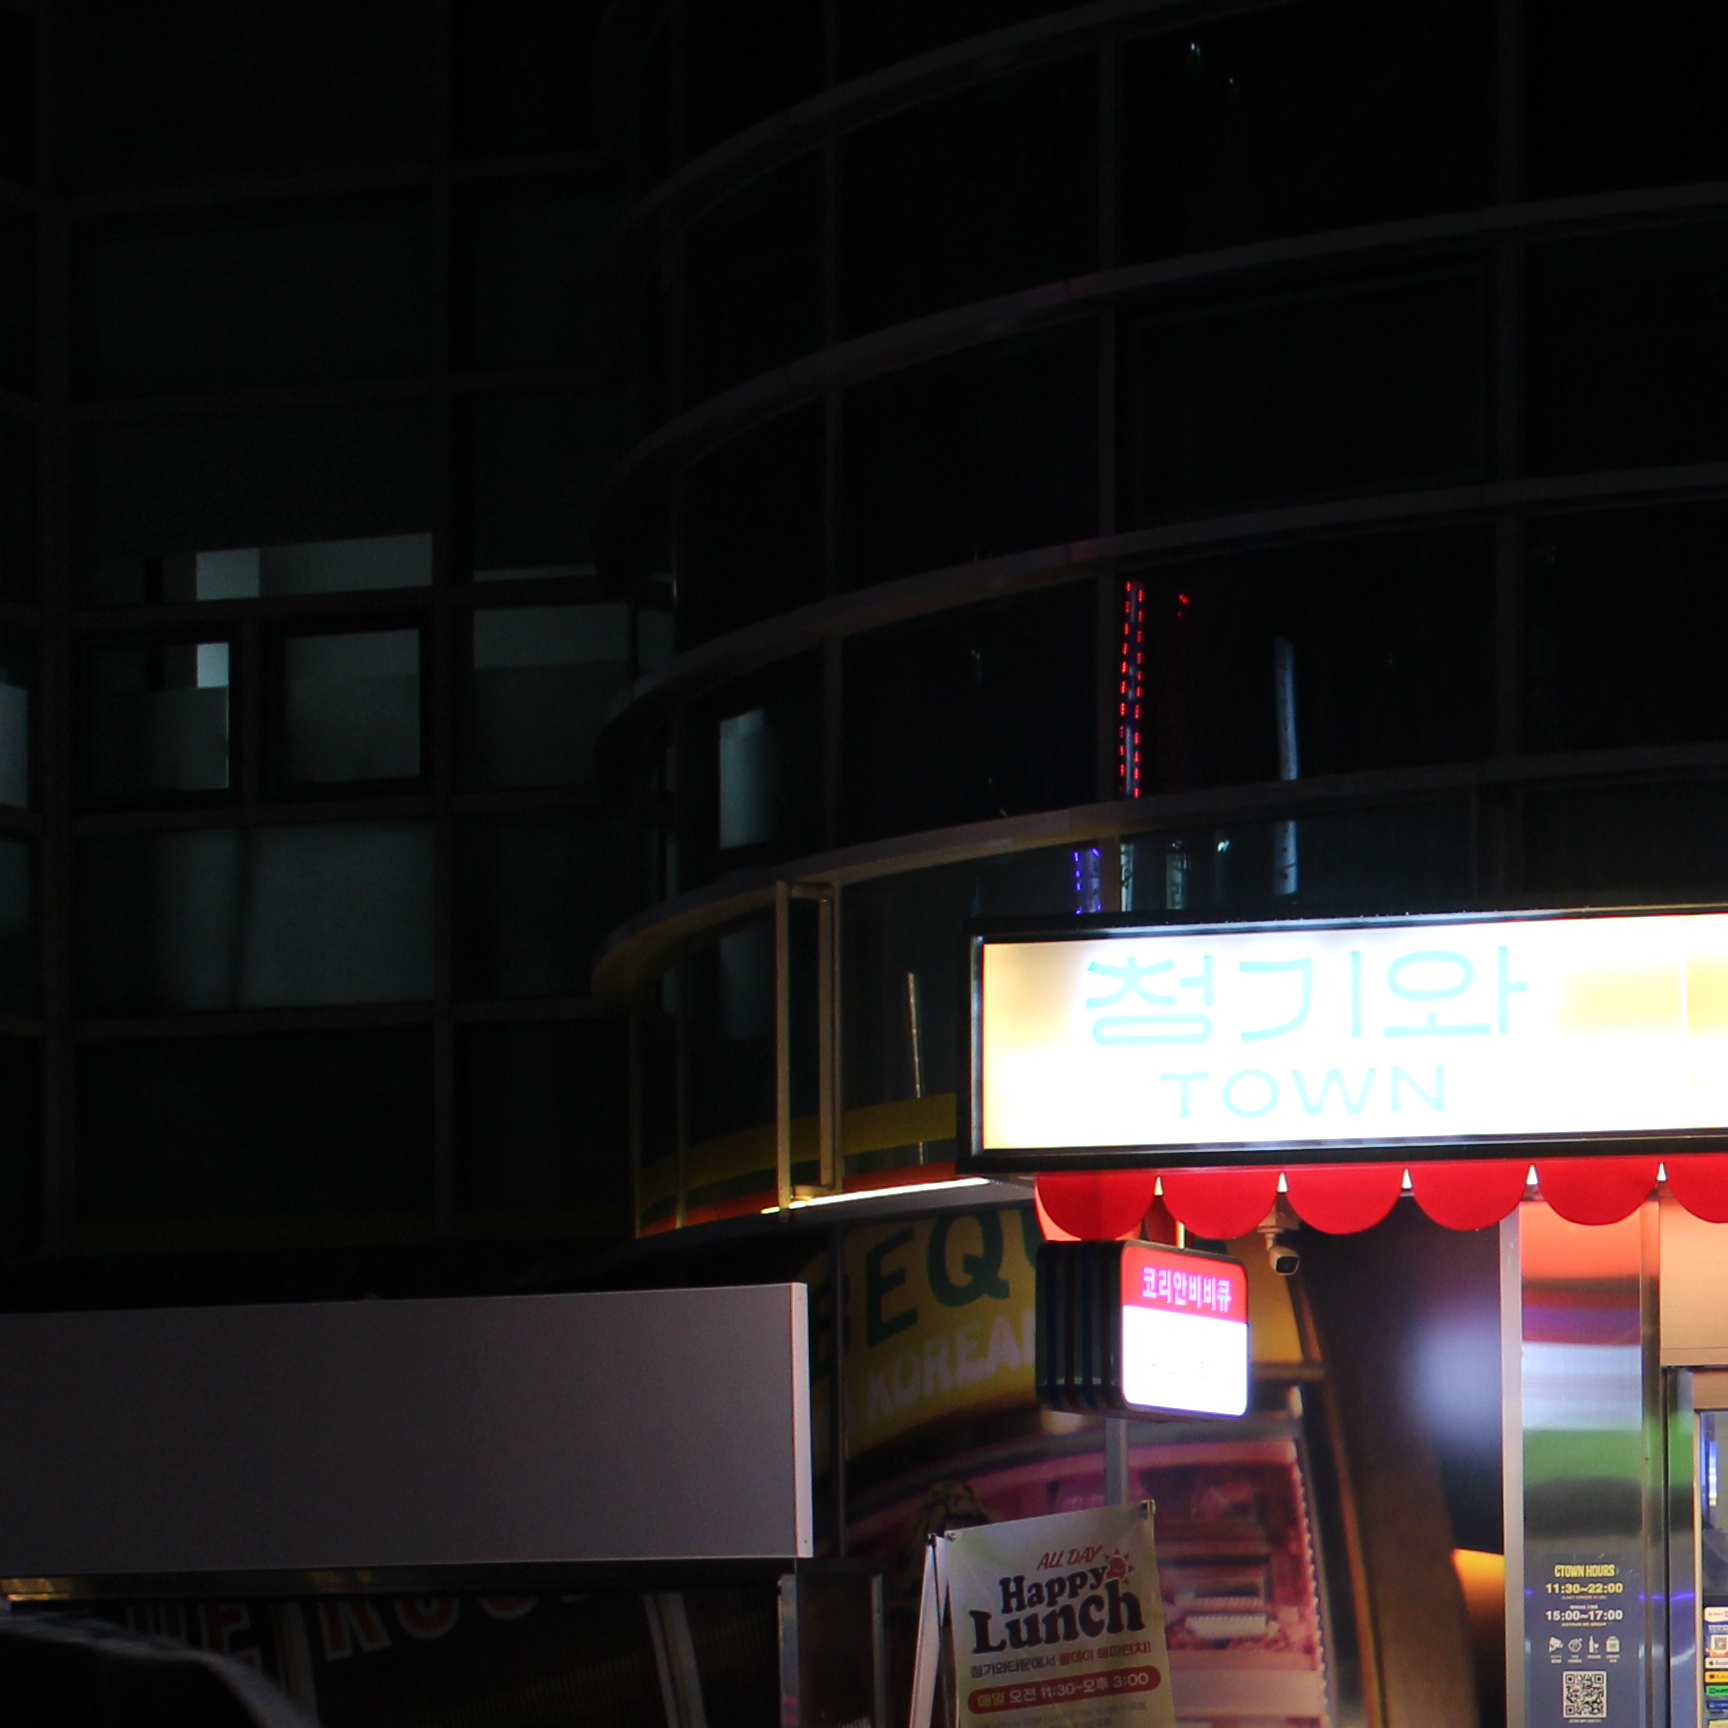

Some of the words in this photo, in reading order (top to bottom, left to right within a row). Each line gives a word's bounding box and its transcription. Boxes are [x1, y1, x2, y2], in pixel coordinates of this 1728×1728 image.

[1085, 945, 1530, 1046] 청기와
[1158, 1064, 1447, 1119] TOWN
[1142, 1267, 1231, 1313] 코리안비비큐
[1037, 1551, 1064, 1570] ALL
[1068, 1545, 1103, 1564] DAY
[1585, 1564, 1616, 1577] HOURS
[999, 1565, 1109, 1614] Happy
[1545, 1583, 1624, 1594] 11:30~22:00
[969, 1578, 1145, 1654] Lunch
[1545, 1610, 1623, 1621] 15:00~17:00
[970, 1655, 1056, 1679] 청기와타운에서
[1009, 1688, 1037, 1704] 오전
[1113, 1672, 1149, 1688] 3:00
